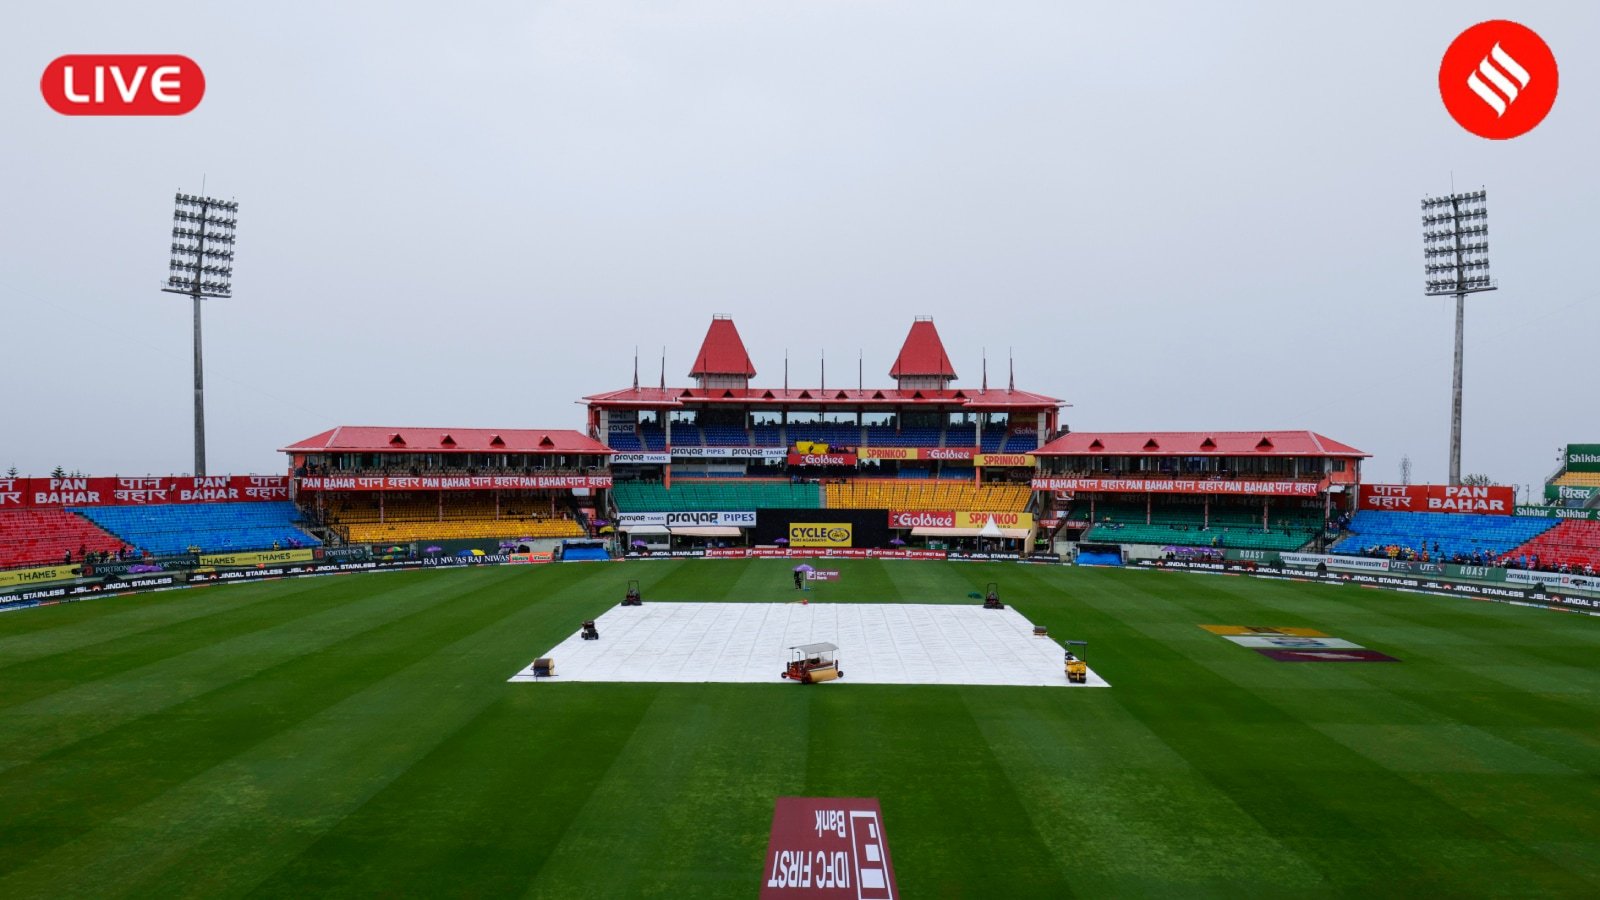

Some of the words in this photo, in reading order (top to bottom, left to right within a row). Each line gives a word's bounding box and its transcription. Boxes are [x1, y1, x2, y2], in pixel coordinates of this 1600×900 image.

[608, 424, 634, 432] rayag
[671, 448, 703, 456] prayag
[866, 449, 907, 458] SPRINKOO
[614, 454, 644, 462] prayag
[984, 456, 1025, 465] SPRINKOO
[1570, 454, 1600, 462] Shikha
[50, 479, 86, 490] PAN
[119, 478, 162, 489] पान
[194, 478, 226, 488] PAN
[250, 476, 283, 487] पान
[302, 478, 320, 488] PAN
[324, 478, 356, 488] BAHAR
[358, 477, 384, 488] पान
[388, 477, 420, 488] बहार
[422, 478, 439, 487] PAN
[442, 478, 470, 487] BAHAR
[472, 477, 492, 486] पान
[494, 477, 520, 487] बहार
[520, 477, 536, 486] PAN
[538, 477, 566, 486] BAHAR
[566, 477, 586, 486] पान
[588, 477, 613, 486] बहार
[1032, 479, 1048, 488] PAN
[1050, 479, 1078, 489] BAHAR
[1078, 479, 1098, 489] पान
[1101, 480, 1125, 490] बहार
[1126, 480, 1142, 490] PAN
[1145, 480, 1174, 490] BAHAR
[1175, 480, 1194, 490] पान
[1198, 480, 1224, 491] बहार
[1224, 482, 1242, 492] PAN
[1244, 482, 1274, 492] BAHAR
[1276, 482, 1293, 492] पान
[1295, 483, 1318, 494] बहार
[114, 490, 168, 502] बहार
[180, 488, 239, 500] BAHAR
[246, 487, 288, 498] बहार
[1373, 486, 1408, 496] पान
[1446, 486, 1488, 498] PAN
[35, 492, 100, 504] BAHAR
[1368, 496, 1412, 508] बहार
[1428, 498, 1504, 510] BAHAR
[1516, 507, 1549, 516] Shikhar
[1556, 509, 1590, 518] Shikhar
[666, 513, 718, 525] prayag
[724, 514, 754, 522] PIPES
[969, 513, 1018, 524] SPRNKOO
[791, 528, 827, 538] CYCLE
[257, 553, 291, 561] THAMES
[1240, 550, 1265, 559] ROAST
[202, 557, 236, 565] THAMES
[468, 556, 482, 564] RAJ
[96, 564, 129, 573] PORTRON
[246, 568, 283, 577] STAINLESS
[1460, 566, 1490, 576] ROAST
[17, 570, 57, 580] THAMES
[0, 594, 21, 603] NDAL
[23, 589, 64, 600] STAINLESS
[104, 582, 130, 590] JINDAL
[132, 578, 172, 588] STAINLESS
[1378, 577, 1418, 586] STAINLESS
[1482, 588, 1524, 598] STAINLESS
[1562, 598, 1591, 606] JINDAL
[815, 810, 846, 838] Bank
[768, 850, 812, 888] FIRST
[816, 850, 850, 888] IDFC
